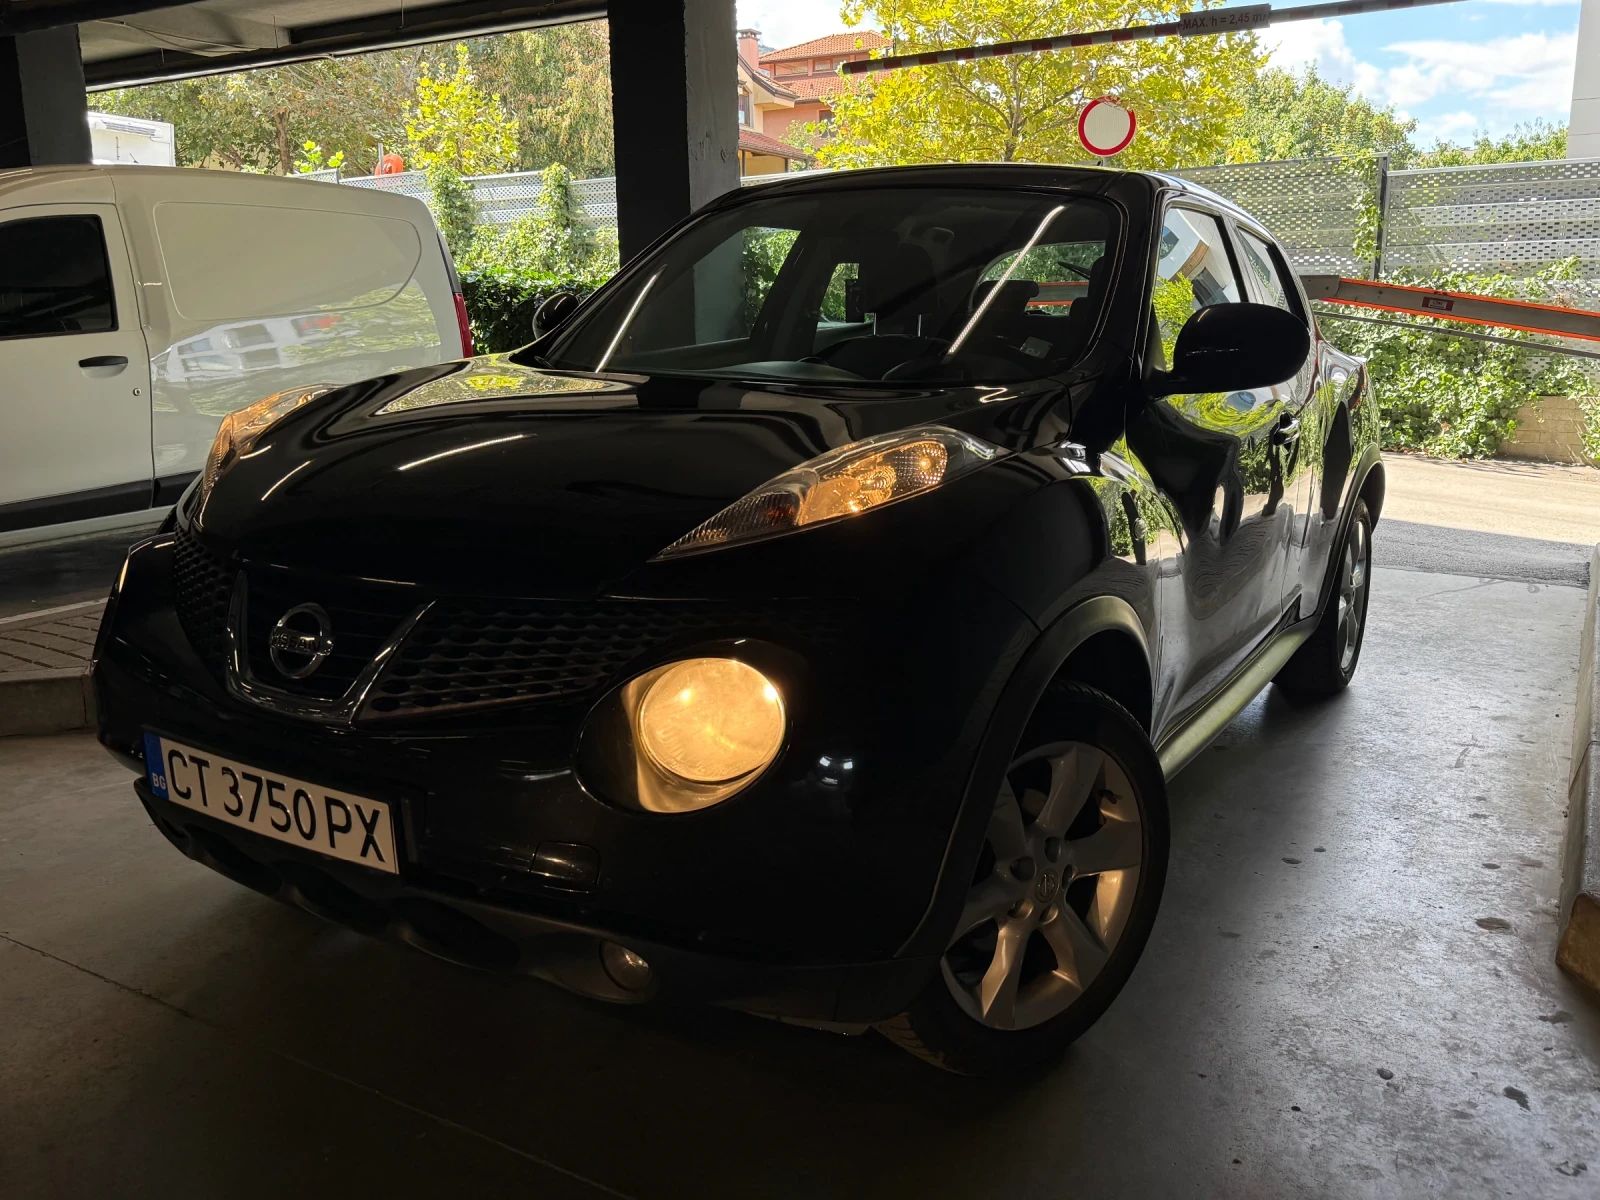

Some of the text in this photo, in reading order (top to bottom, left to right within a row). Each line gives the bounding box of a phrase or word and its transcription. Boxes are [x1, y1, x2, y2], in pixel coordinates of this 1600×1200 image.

[1182, 16, 1208, 30] MAX.
[1211, 15, 1218, 27] h
[1229, 13, 1250, 26] 2,45
[152, 772, 167, 790] BG
[168, 749, 386, 863] CT 3750 PX
